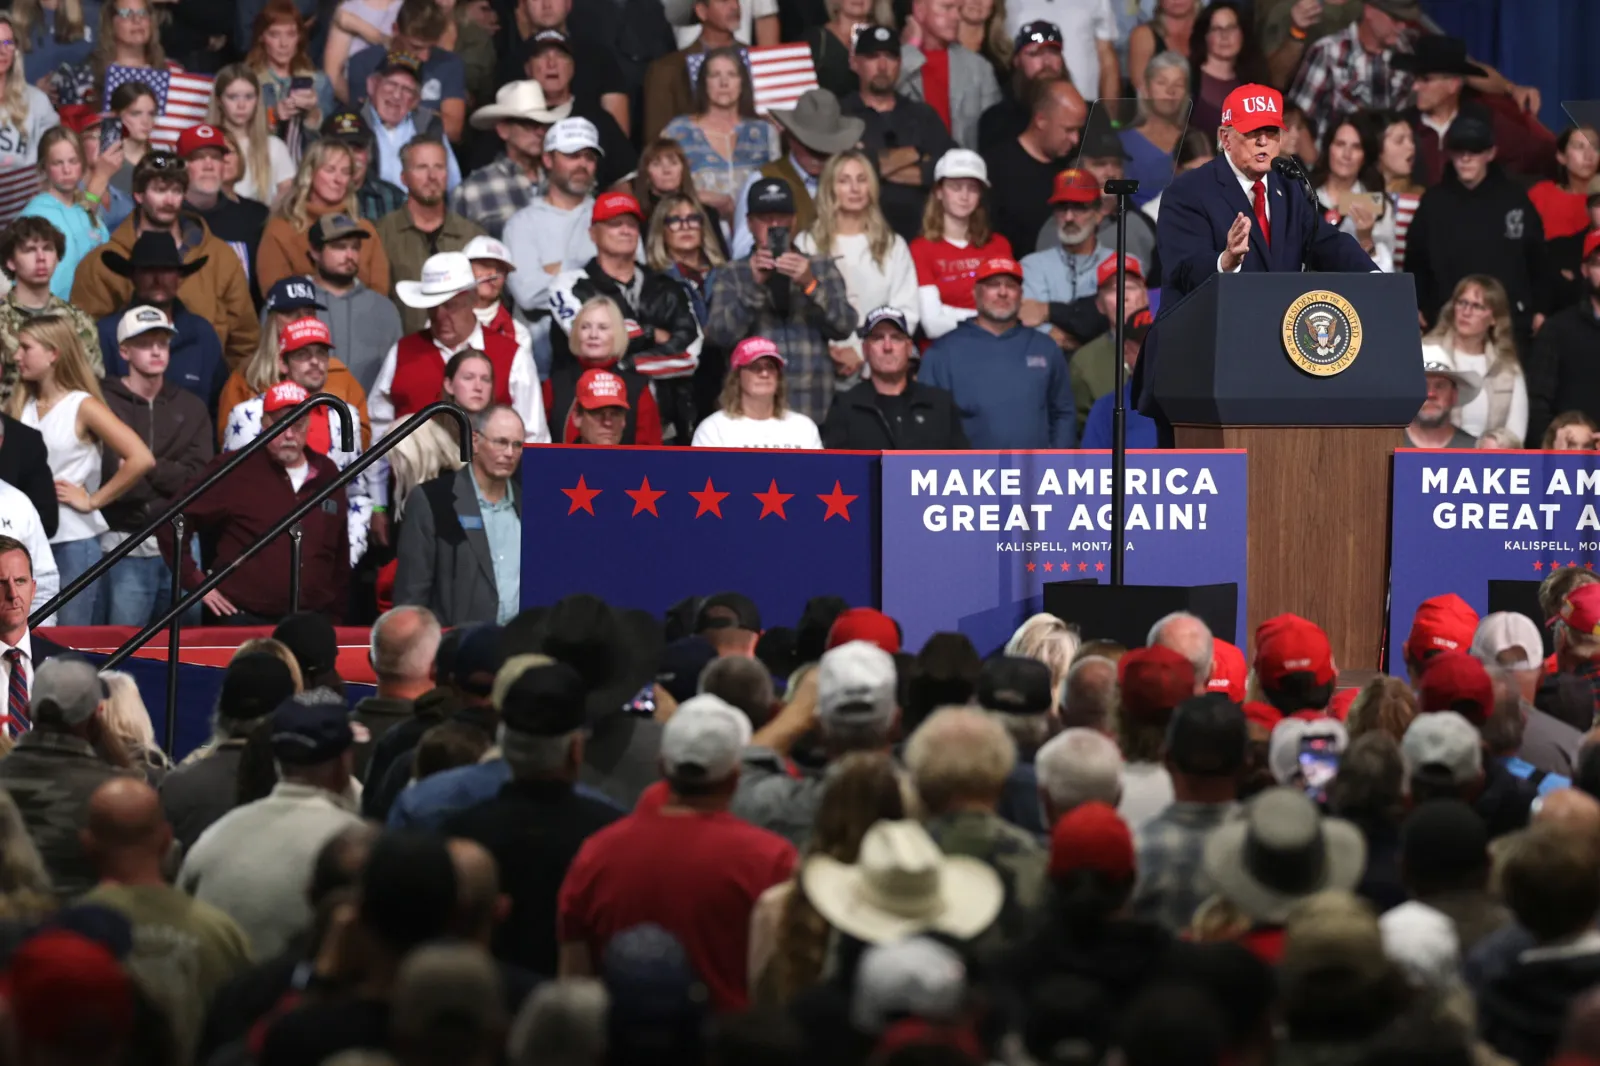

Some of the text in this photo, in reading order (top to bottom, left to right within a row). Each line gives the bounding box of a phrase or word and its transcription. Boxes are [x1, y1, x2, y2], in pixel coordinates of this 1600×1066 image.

[1242, 96, 1277, 113] USA
[286, 282, 315, 300] USA
[1285, 294, 1319, 331] PRESIDENT
[1341, 303, 1359, 338] UNITED
[1330, 345, 1357, 372] STATES
[910, 468, 1218, 496] MAKE AMERICA
[1421, 467, 1531, 494] MAKE
[922, 503, 1208, 532] GREAT AGAIN!
[1432, 502, 1561, 530] GREAT
[996, 541, 1134, 553] KALISPELL, MONTAA
[1504, 540, 1600, 552] KALISPELL, MO
[1432, 636, 1459, 650] TRUMP
[1283, 658, 1312, 670] TRUMP
